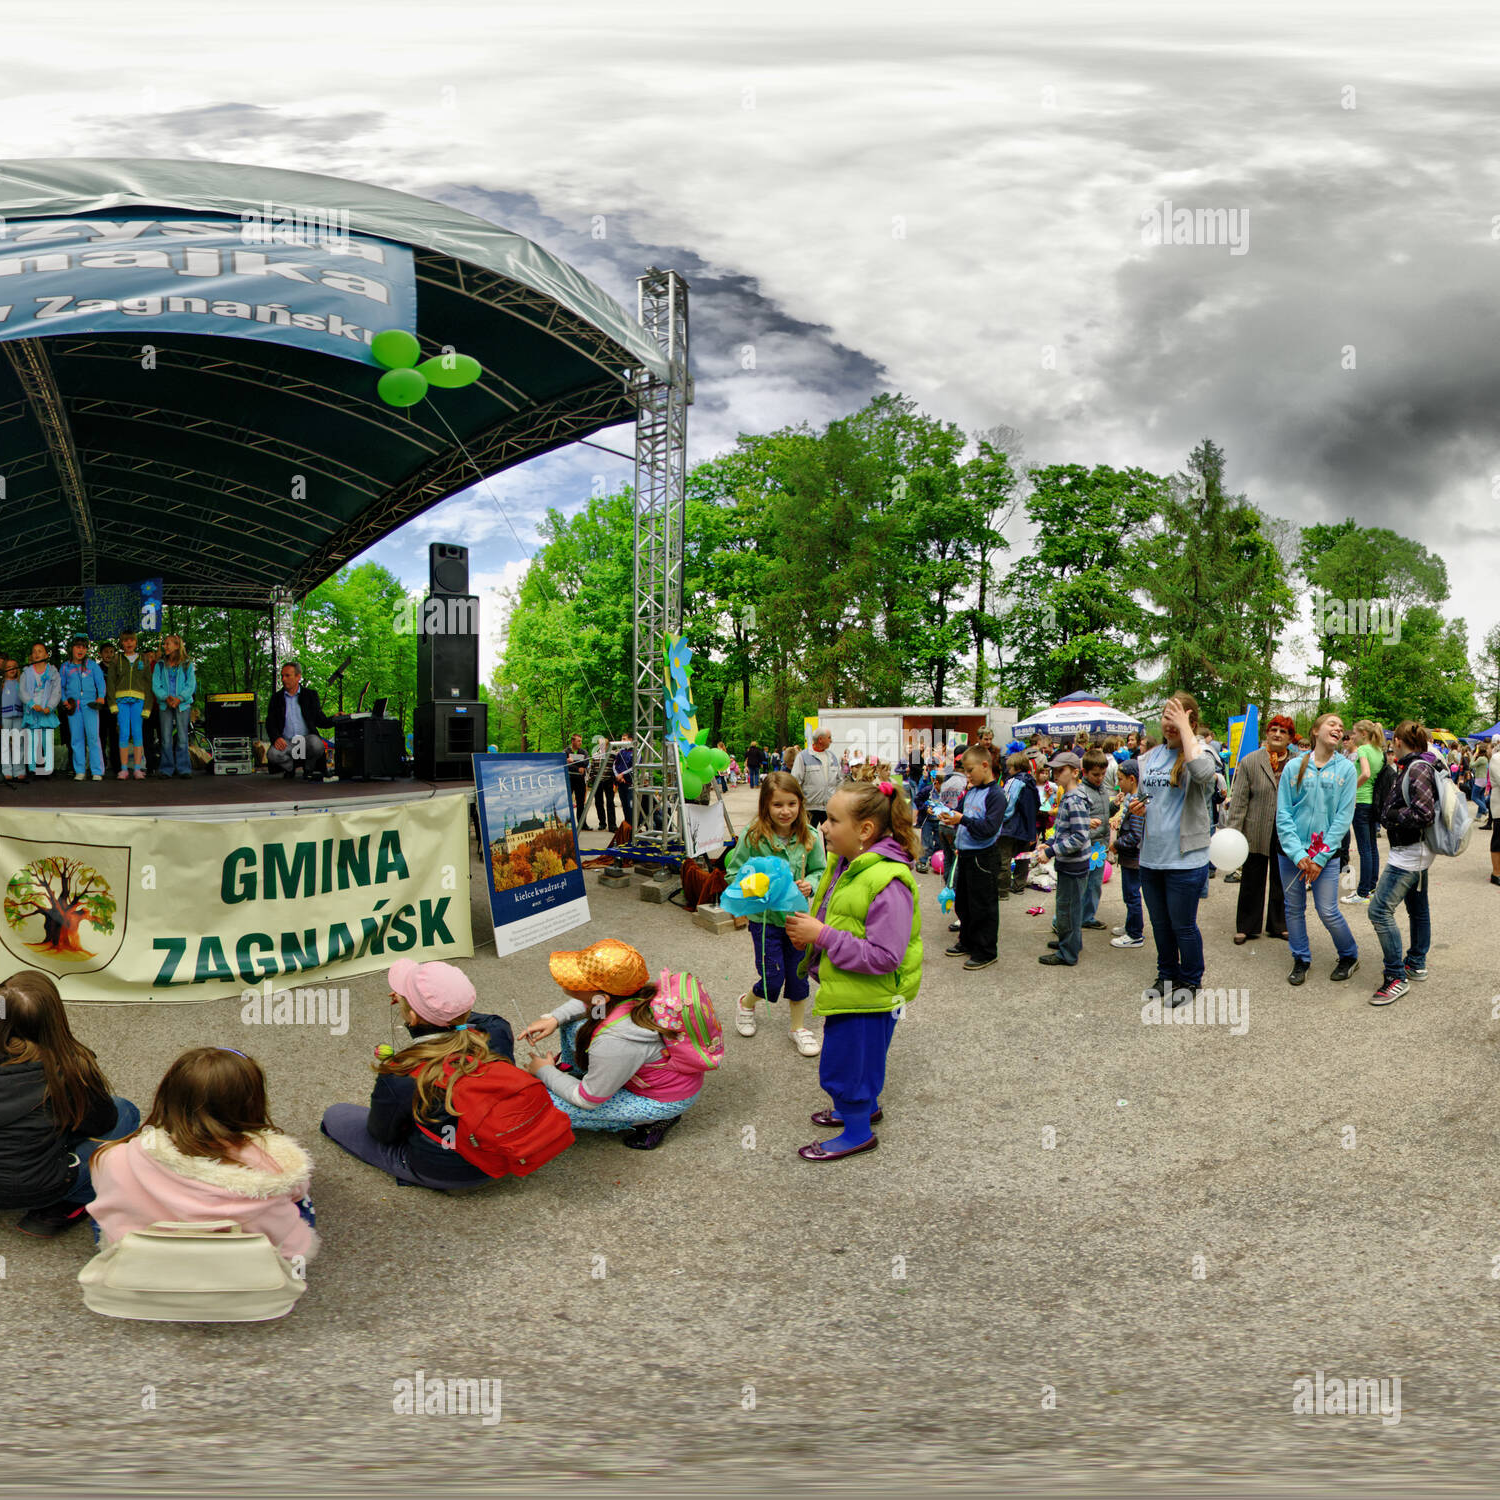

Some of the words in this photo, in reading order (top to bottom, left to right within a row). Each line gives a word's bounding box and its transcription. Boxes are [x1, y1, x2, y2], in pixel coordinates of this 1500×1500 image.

[498, 773, 557, 793] KIELCE
[220, 829, 410, 905] GMINA
[152, 897, 456, 988] ZAGNAŃSK
